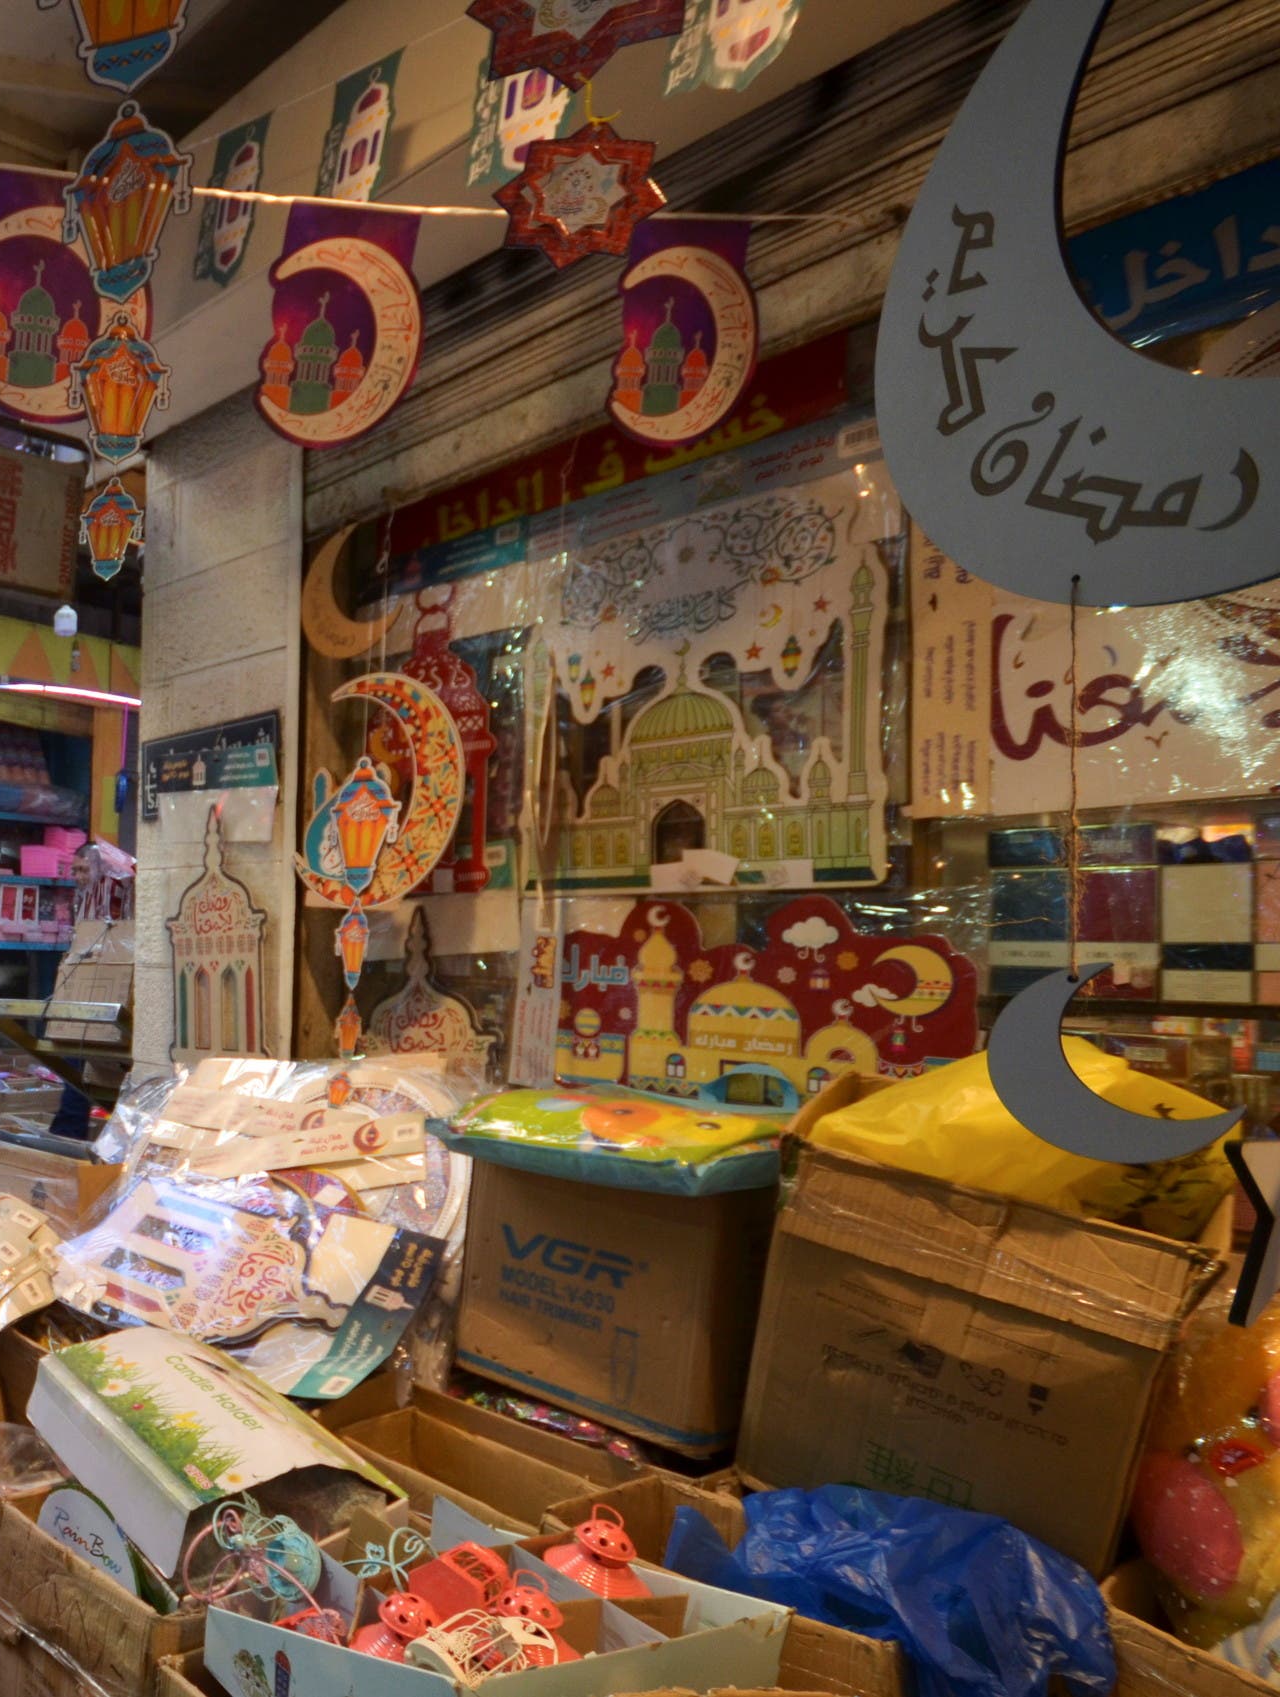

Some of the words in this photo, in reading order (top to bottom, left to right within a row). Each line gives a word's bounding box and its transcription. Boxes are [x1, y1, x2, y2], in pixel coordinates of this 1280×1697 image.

[918, 203, 1018, 435] كريم
[971, 391, 1259, 545] رمضان
[198, 892, 232, 914] رمضان
[561, 944, 629, 990] مبارك
[397, 1007, 446, 1030] رمضان
[695, 1034, 737, 1051] مبارك
[744, 1036, 793, 1056] رمضان
[501, 1224, 631, 1290] VGR
[500, 1289, 534, 1315] HAIR
[535, 1297, 603, 1333] TRIMMER
[165, 1354, 216, 1393] Candle
[210, 1392, 265, 1432] Holder
[54, 1505, 124, 1576] RainBow
